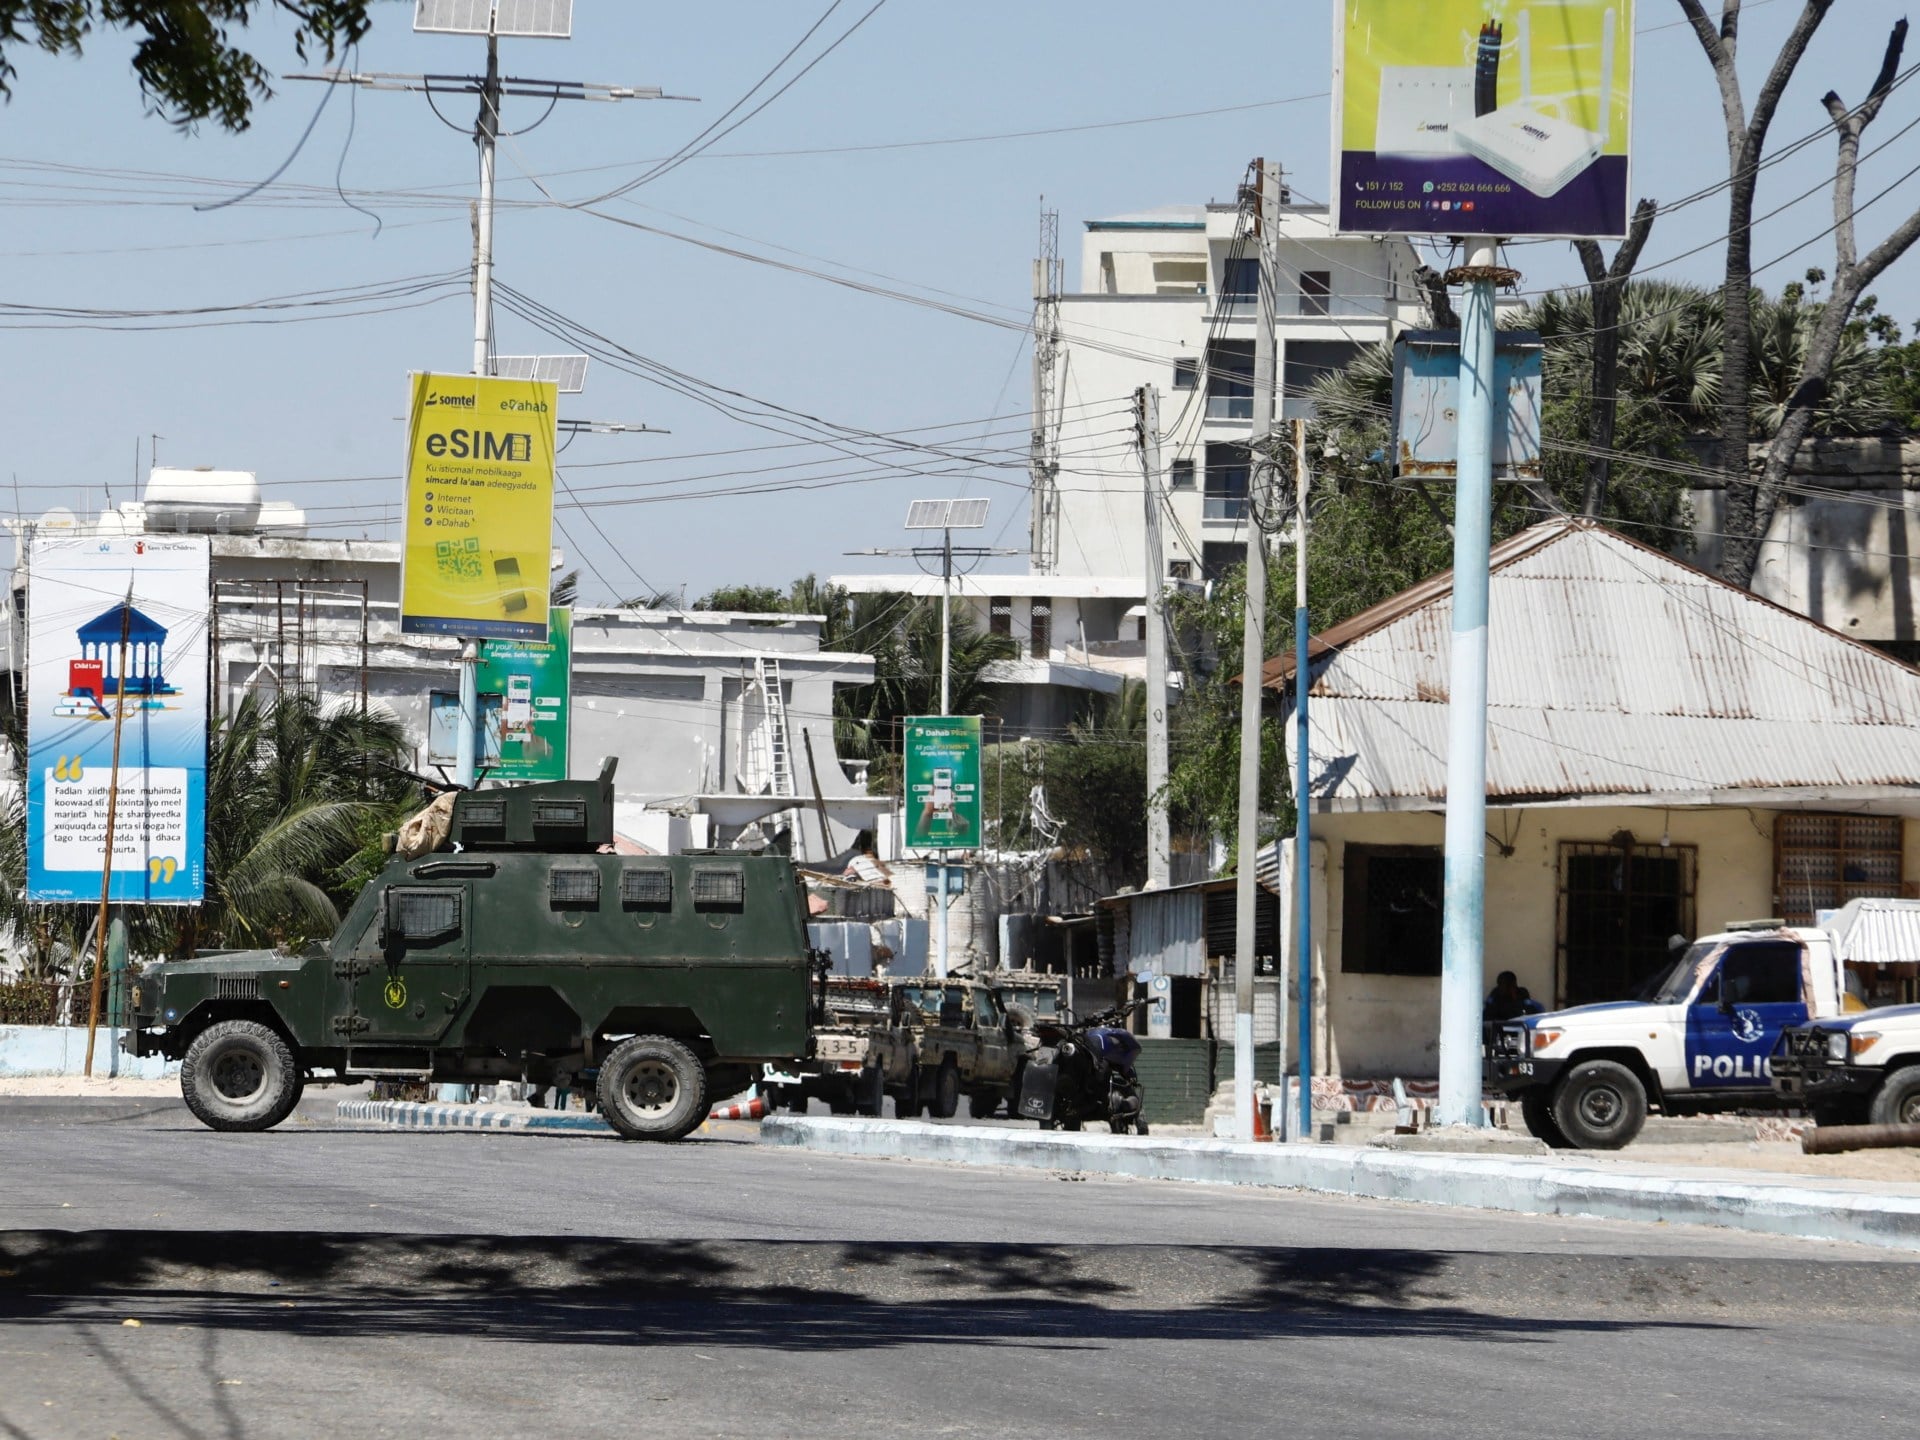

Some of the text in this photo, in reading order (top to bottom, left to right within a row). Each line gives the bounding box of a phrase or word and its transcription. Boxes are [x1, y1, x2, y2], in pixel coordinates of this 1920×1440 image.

[1426, 122, 1448, 130] somtel
[1366, 181, 1379, 191] 151
[1390, 182, 1404, 191] 152
[1436, 182, 1456, 192] +252
[1459, 182, 1474, 192] 624
[1477, 182, 1493, 193] 666
[1494, 182, 1511, 193] 666
[1356, 200, 1421, 209] FOLLOW US ON
[440, 394, 475, 406] somtel
[500, 399, 548, 412] eDahab
[426, 428, 513, 461] eSIM
[426, 464, 522, 479] Ku isticmaal mobilkaaga
[426, 476, 458, 485] simcard
[487, 480, 537, 491] adeegyadda
[438, 494, 472, 503] Internet
[437, 506, 474, 516] Wicitaan
[436, 518, 470, 528] eDahab
[74, 662, 88, 670] Child
[55, 787, 82, 795] Fadlan
[54, 798, 93, 806] koowaad
[146, 798, 159, 809] iyo
[54, 834, 73, 844] tago
[156, 834, 181, 842] dhaca
[832, 1040, 857, 1054] 3-5
